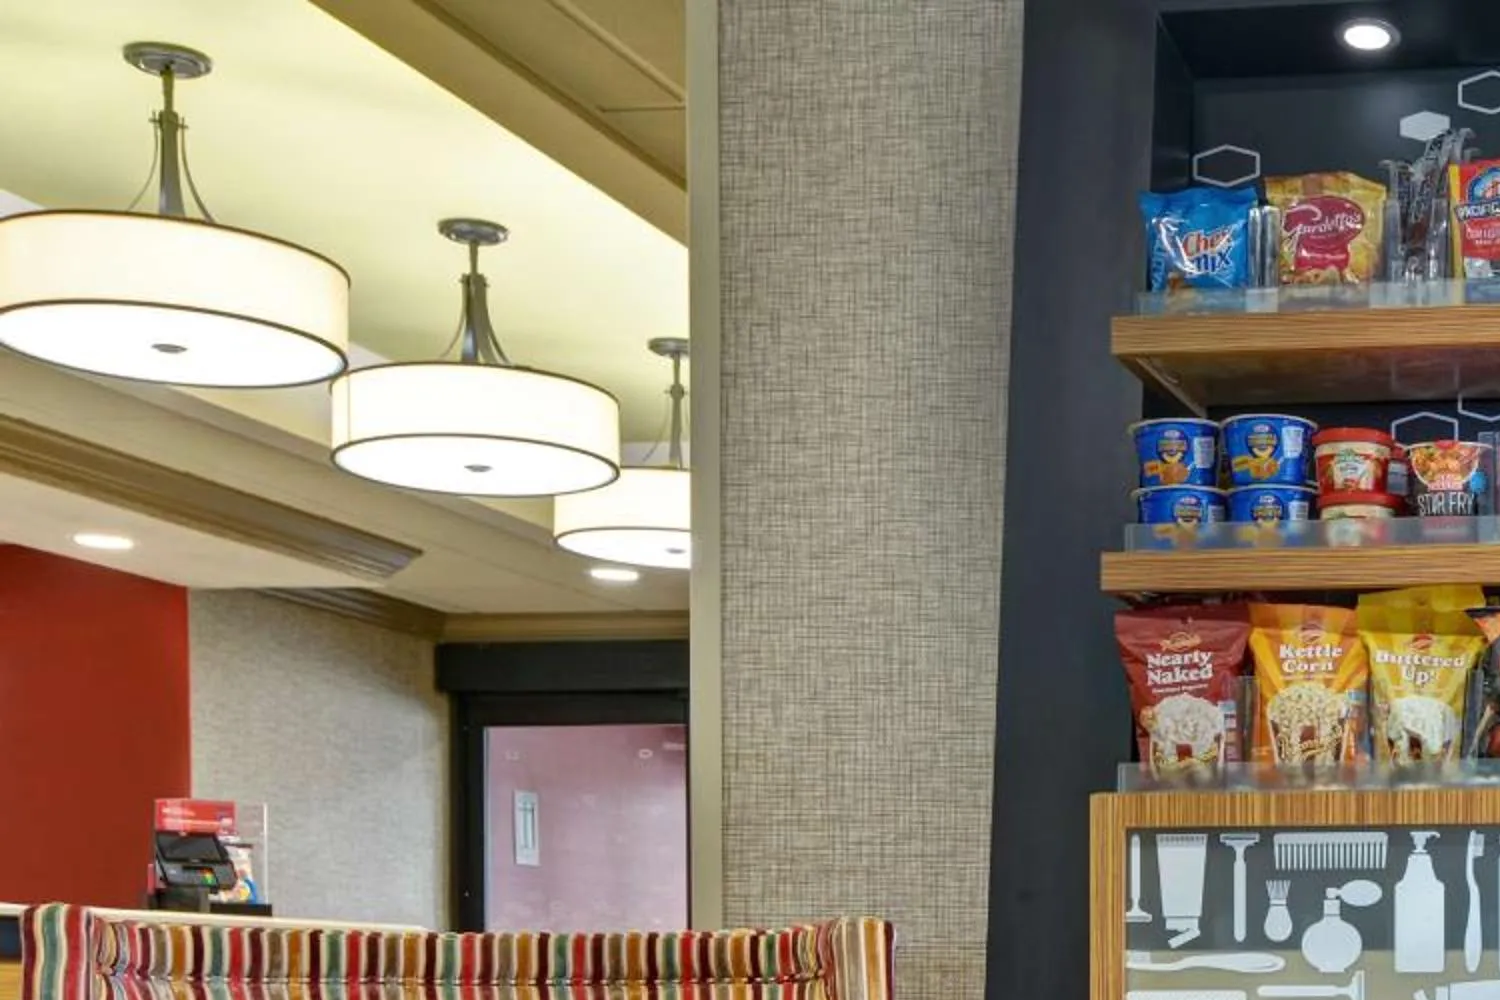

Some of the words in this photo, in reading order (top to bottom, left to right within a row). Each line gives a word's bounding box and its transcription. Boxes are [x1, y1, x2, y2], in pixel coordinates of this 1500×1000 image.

[1418, 492, 1445, 516] STIR
[1450, 491, 1474, 515] FRY
[1147, 650, 1213, 670] Nearly
[1279, 643, 1343, 659] Kettle
[1375, 650, 1465, 668] Buttered
[1147, 663, 1214, 686] Naked
[1281, 657, 1335, 673] Corn
